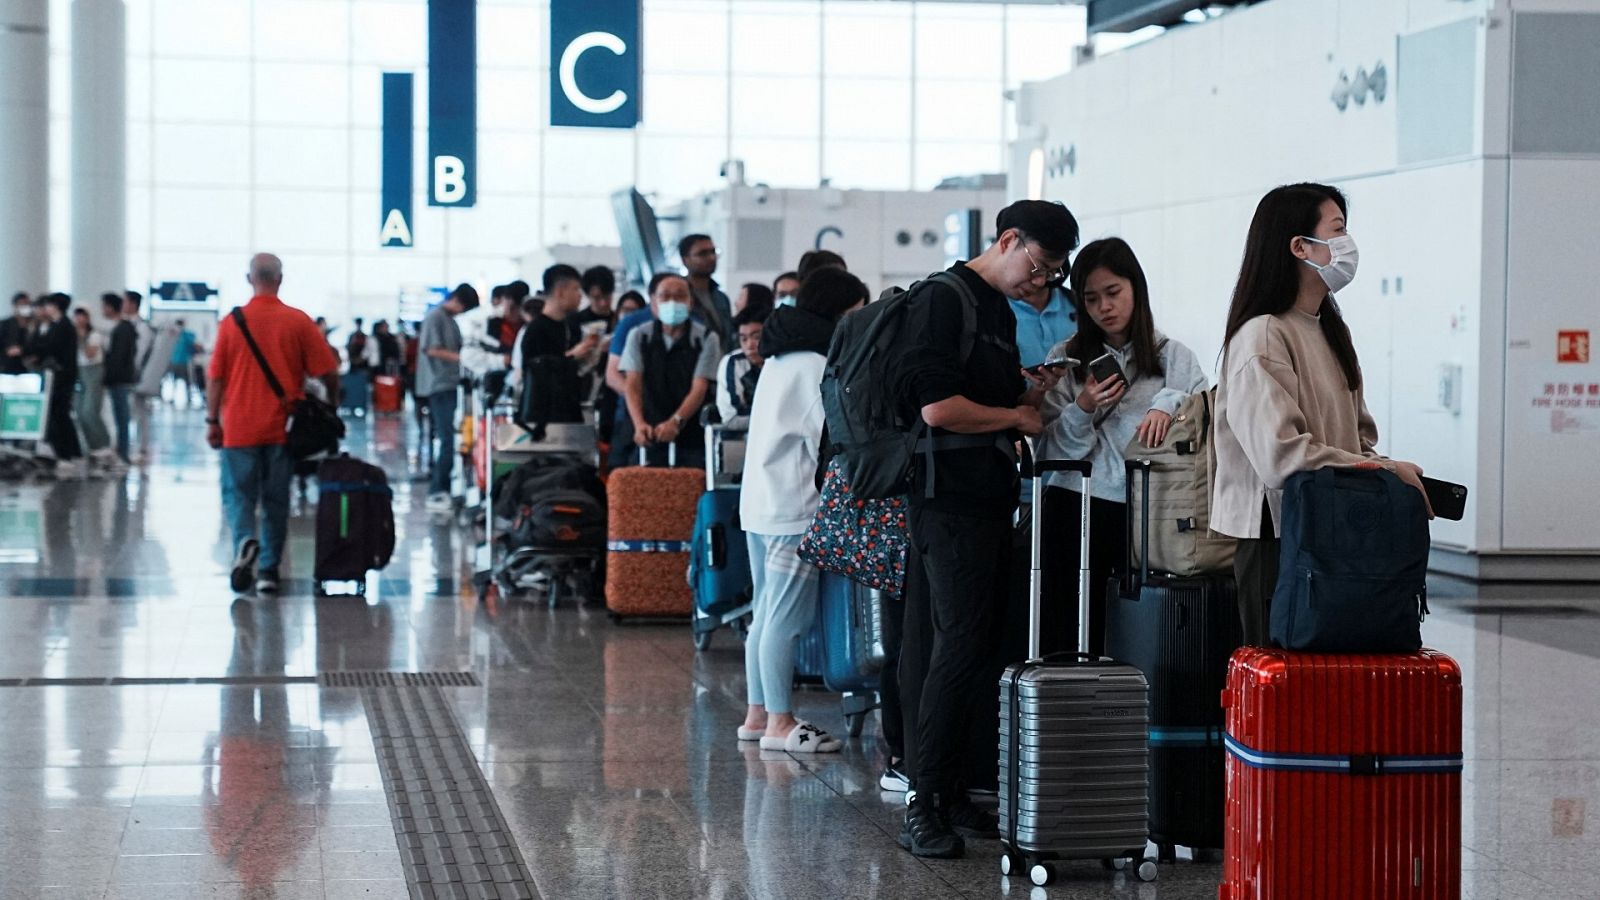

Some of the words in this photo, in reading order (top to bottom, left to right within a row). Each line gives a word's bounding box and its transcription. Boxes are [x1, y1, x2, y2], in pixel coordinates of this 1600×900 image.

[559, 31, 627, 113] C
[434, 155, 466, 203] B
[380, 208, 413, 245] A
[172, 282, 195, 300] A
[1586, 399, 1600, 407] RE
